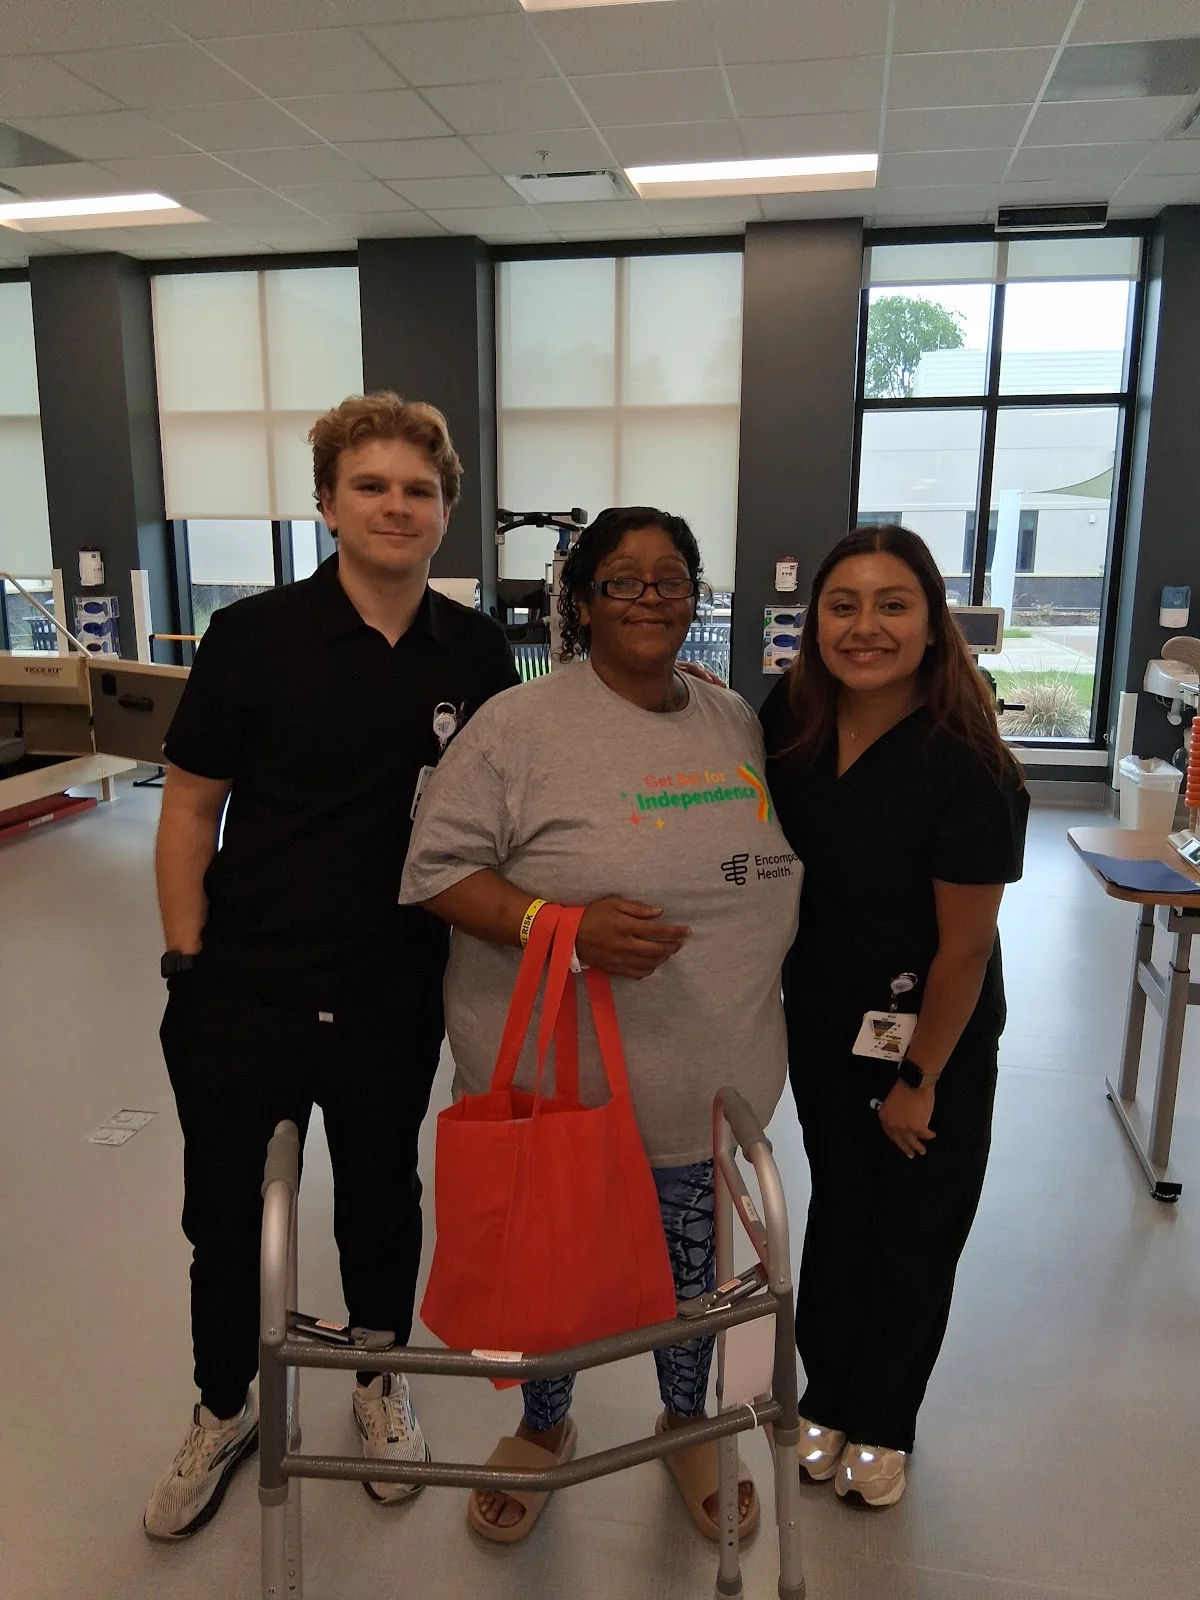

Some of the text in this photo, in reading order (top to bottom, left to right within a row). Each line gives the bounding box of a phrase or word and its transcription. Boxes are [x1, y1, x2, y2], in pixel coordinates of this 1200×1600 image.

[645, 775, 673, 788] Get
[704, 770, 726, 784] for
[637, 786, 757, 810] Independence
[754, 853, 799, 866] Encompa
[522, 914, 533, 935] RISK
